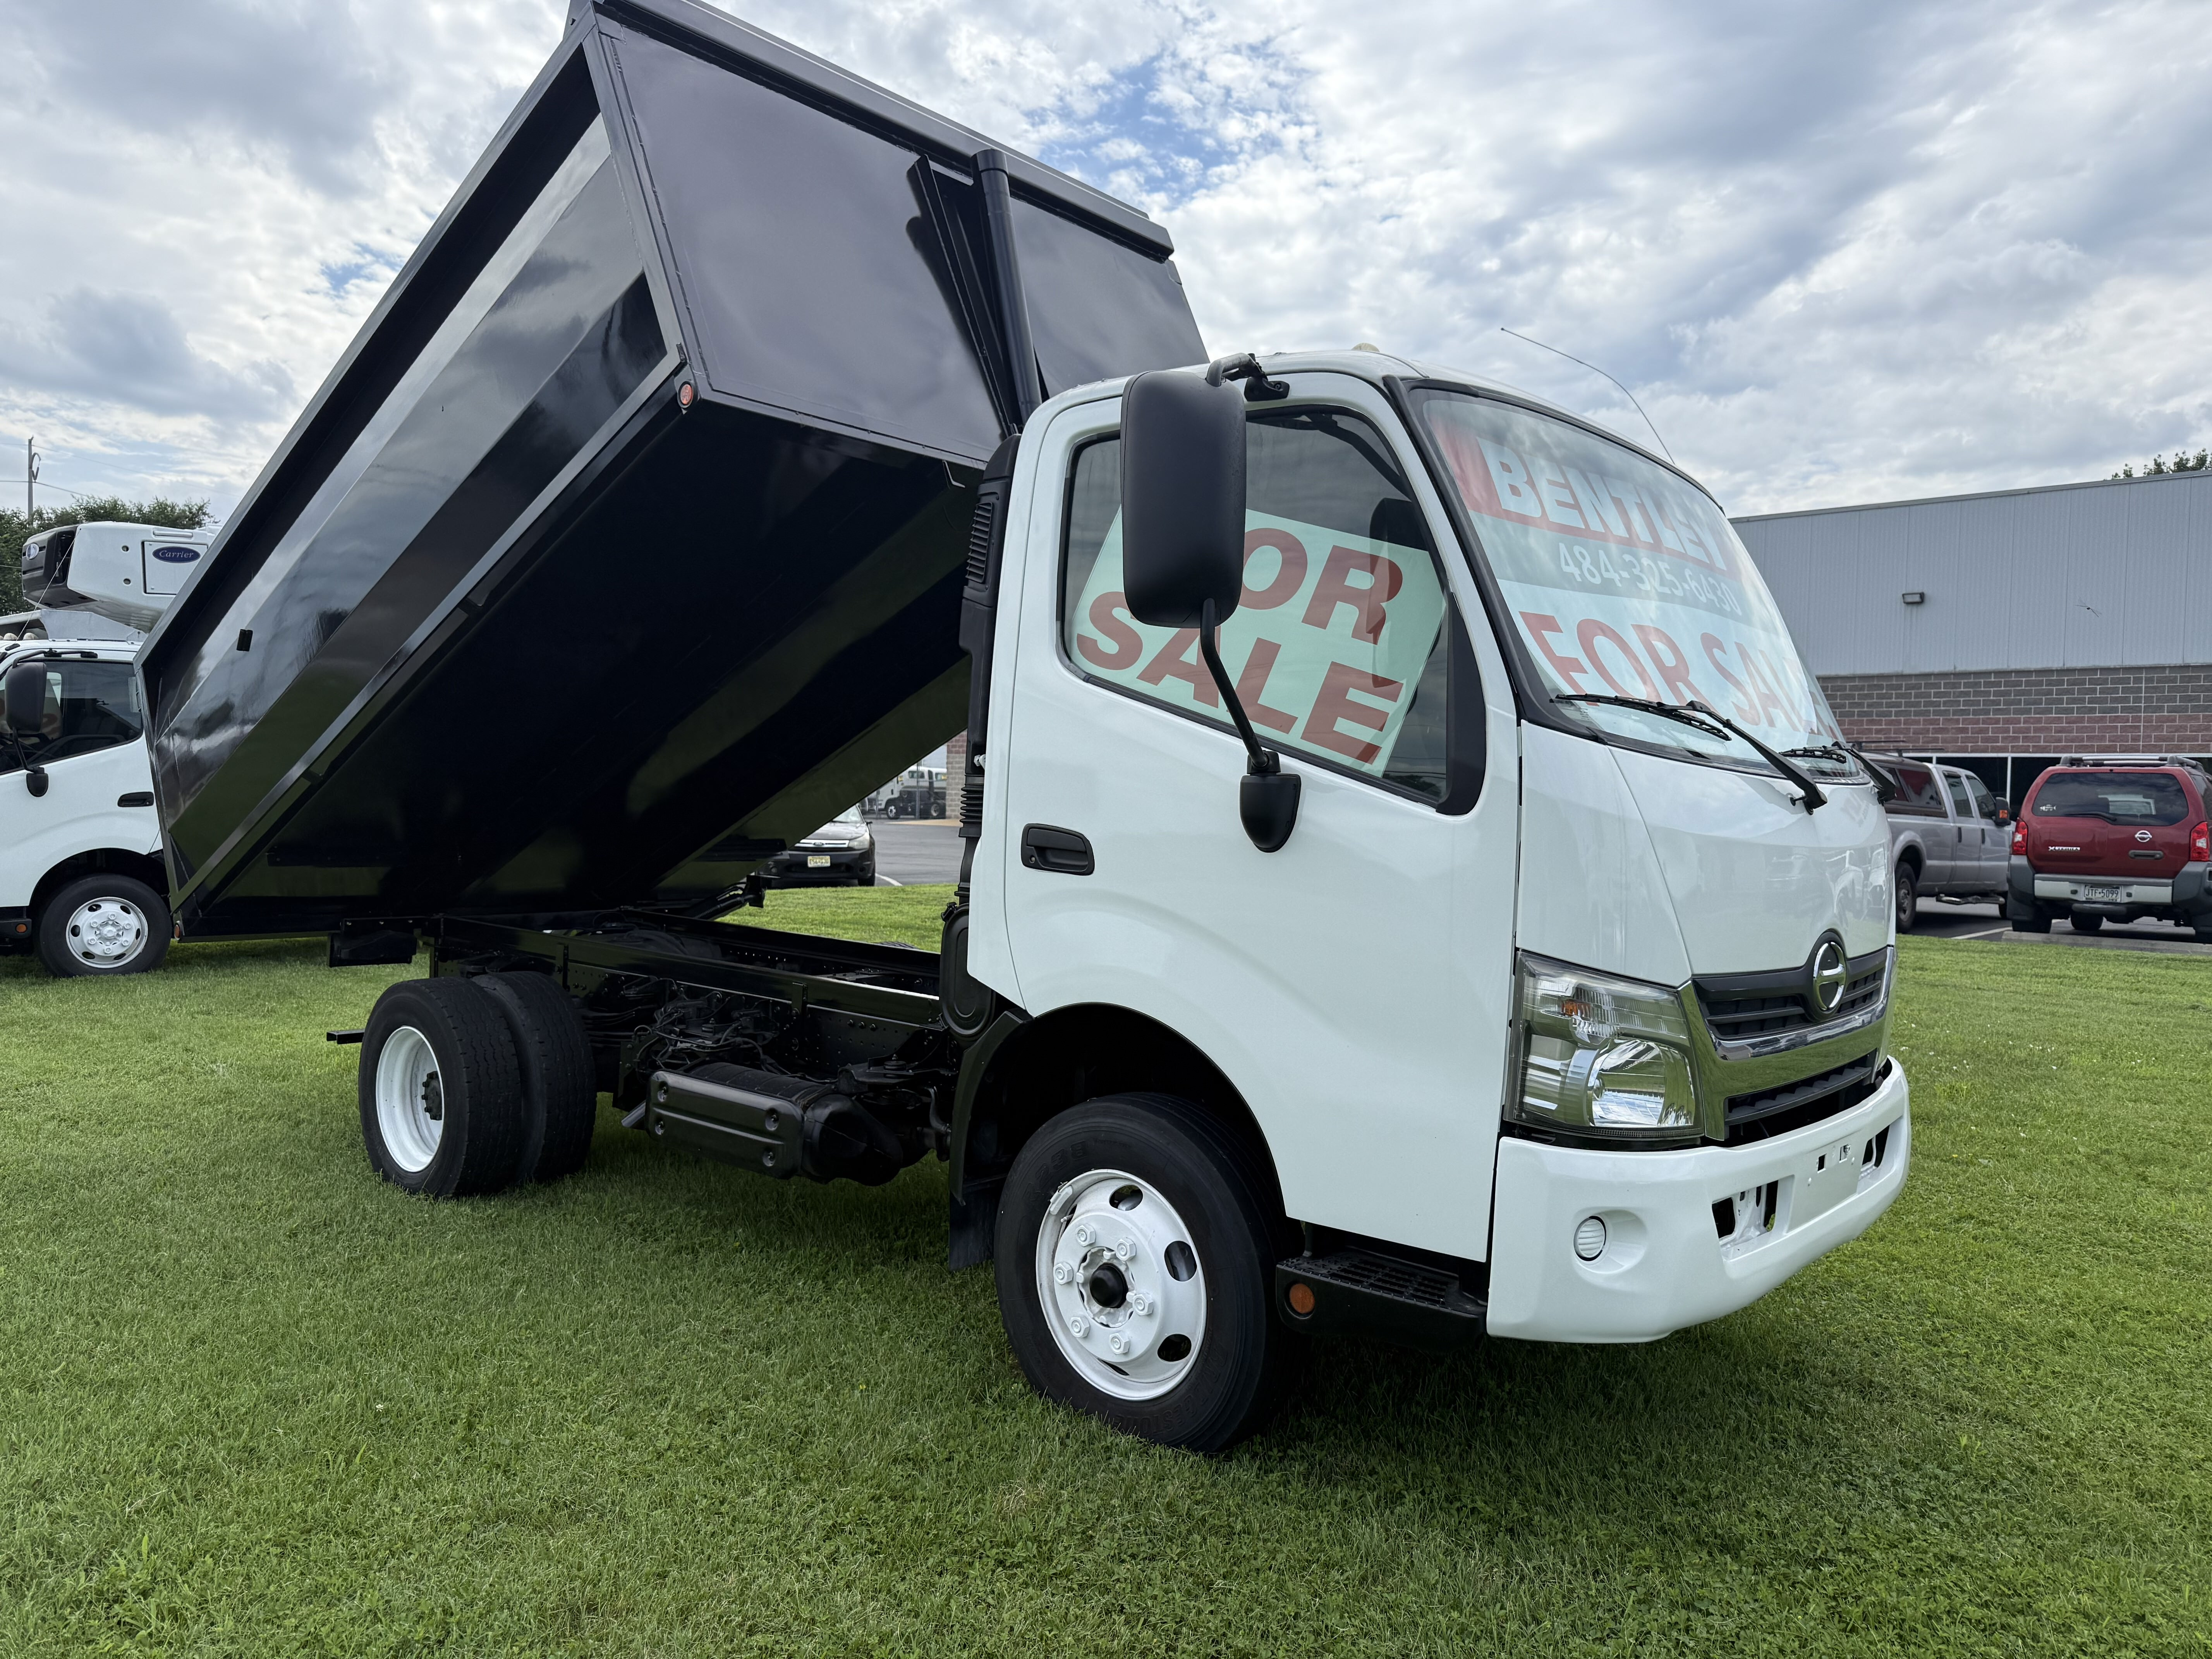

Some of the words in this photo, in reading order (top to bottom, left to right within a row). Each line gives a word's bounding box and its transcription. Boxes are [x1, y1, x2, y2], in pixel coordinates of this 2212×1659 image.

[1476, 437, 1727, 570] BENTLEY
[1238, 528, 1403, 645] OR
[1558, 543, 1742, 616] 484-325-6430
[1077, 591, 1404, 765] SALE
[1519, 611, 1721, 717] FOR
